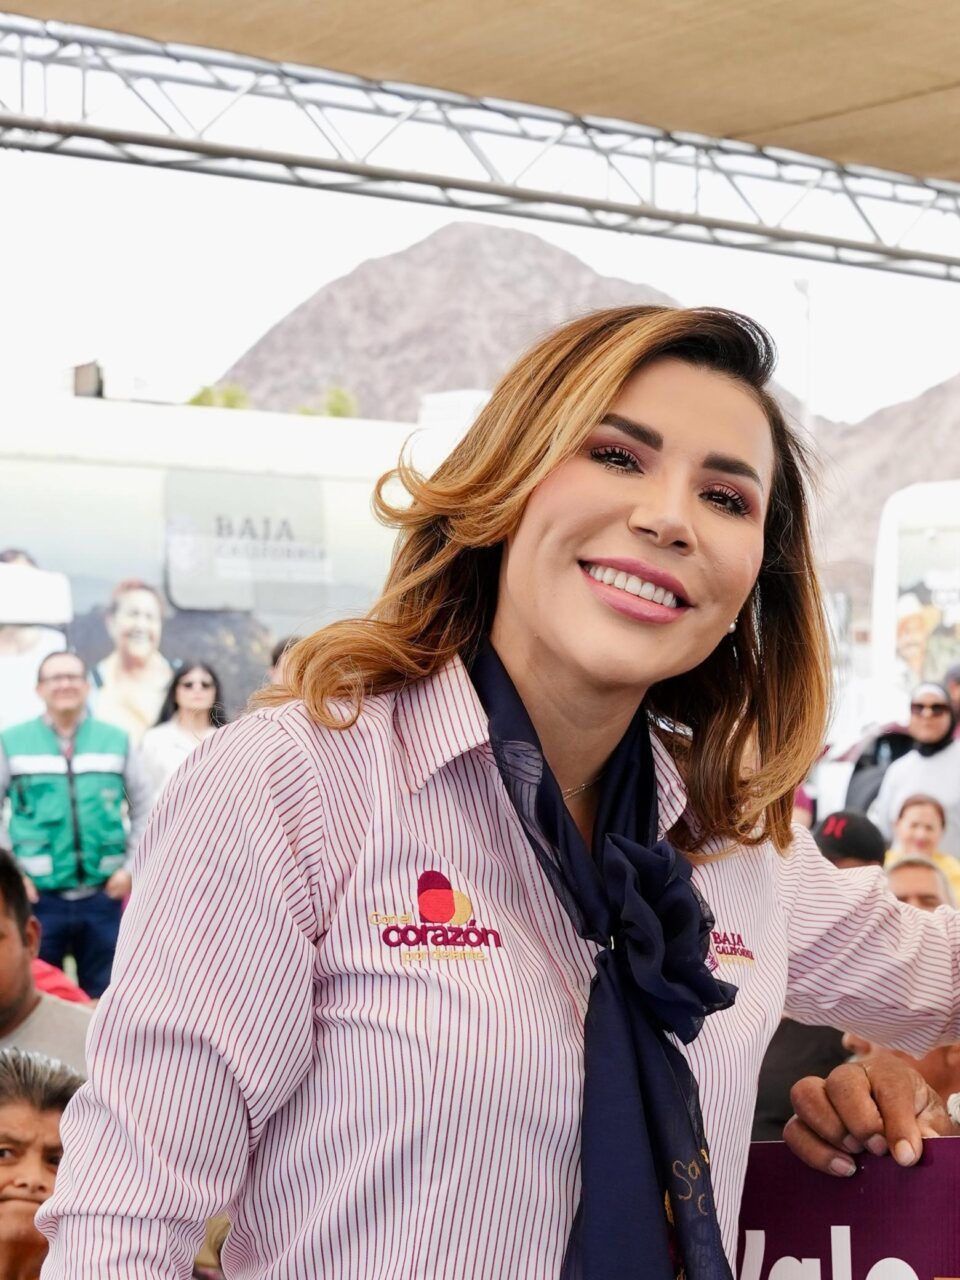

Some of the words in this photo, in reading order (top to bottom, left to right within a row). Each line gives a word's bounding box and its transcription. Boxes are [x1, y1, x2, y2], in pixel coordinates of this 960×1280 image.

[214, 515, 295, 542] BAJA
[382, 919, 501, 948] corazón
[711, 931, 745, 948] BAJA
